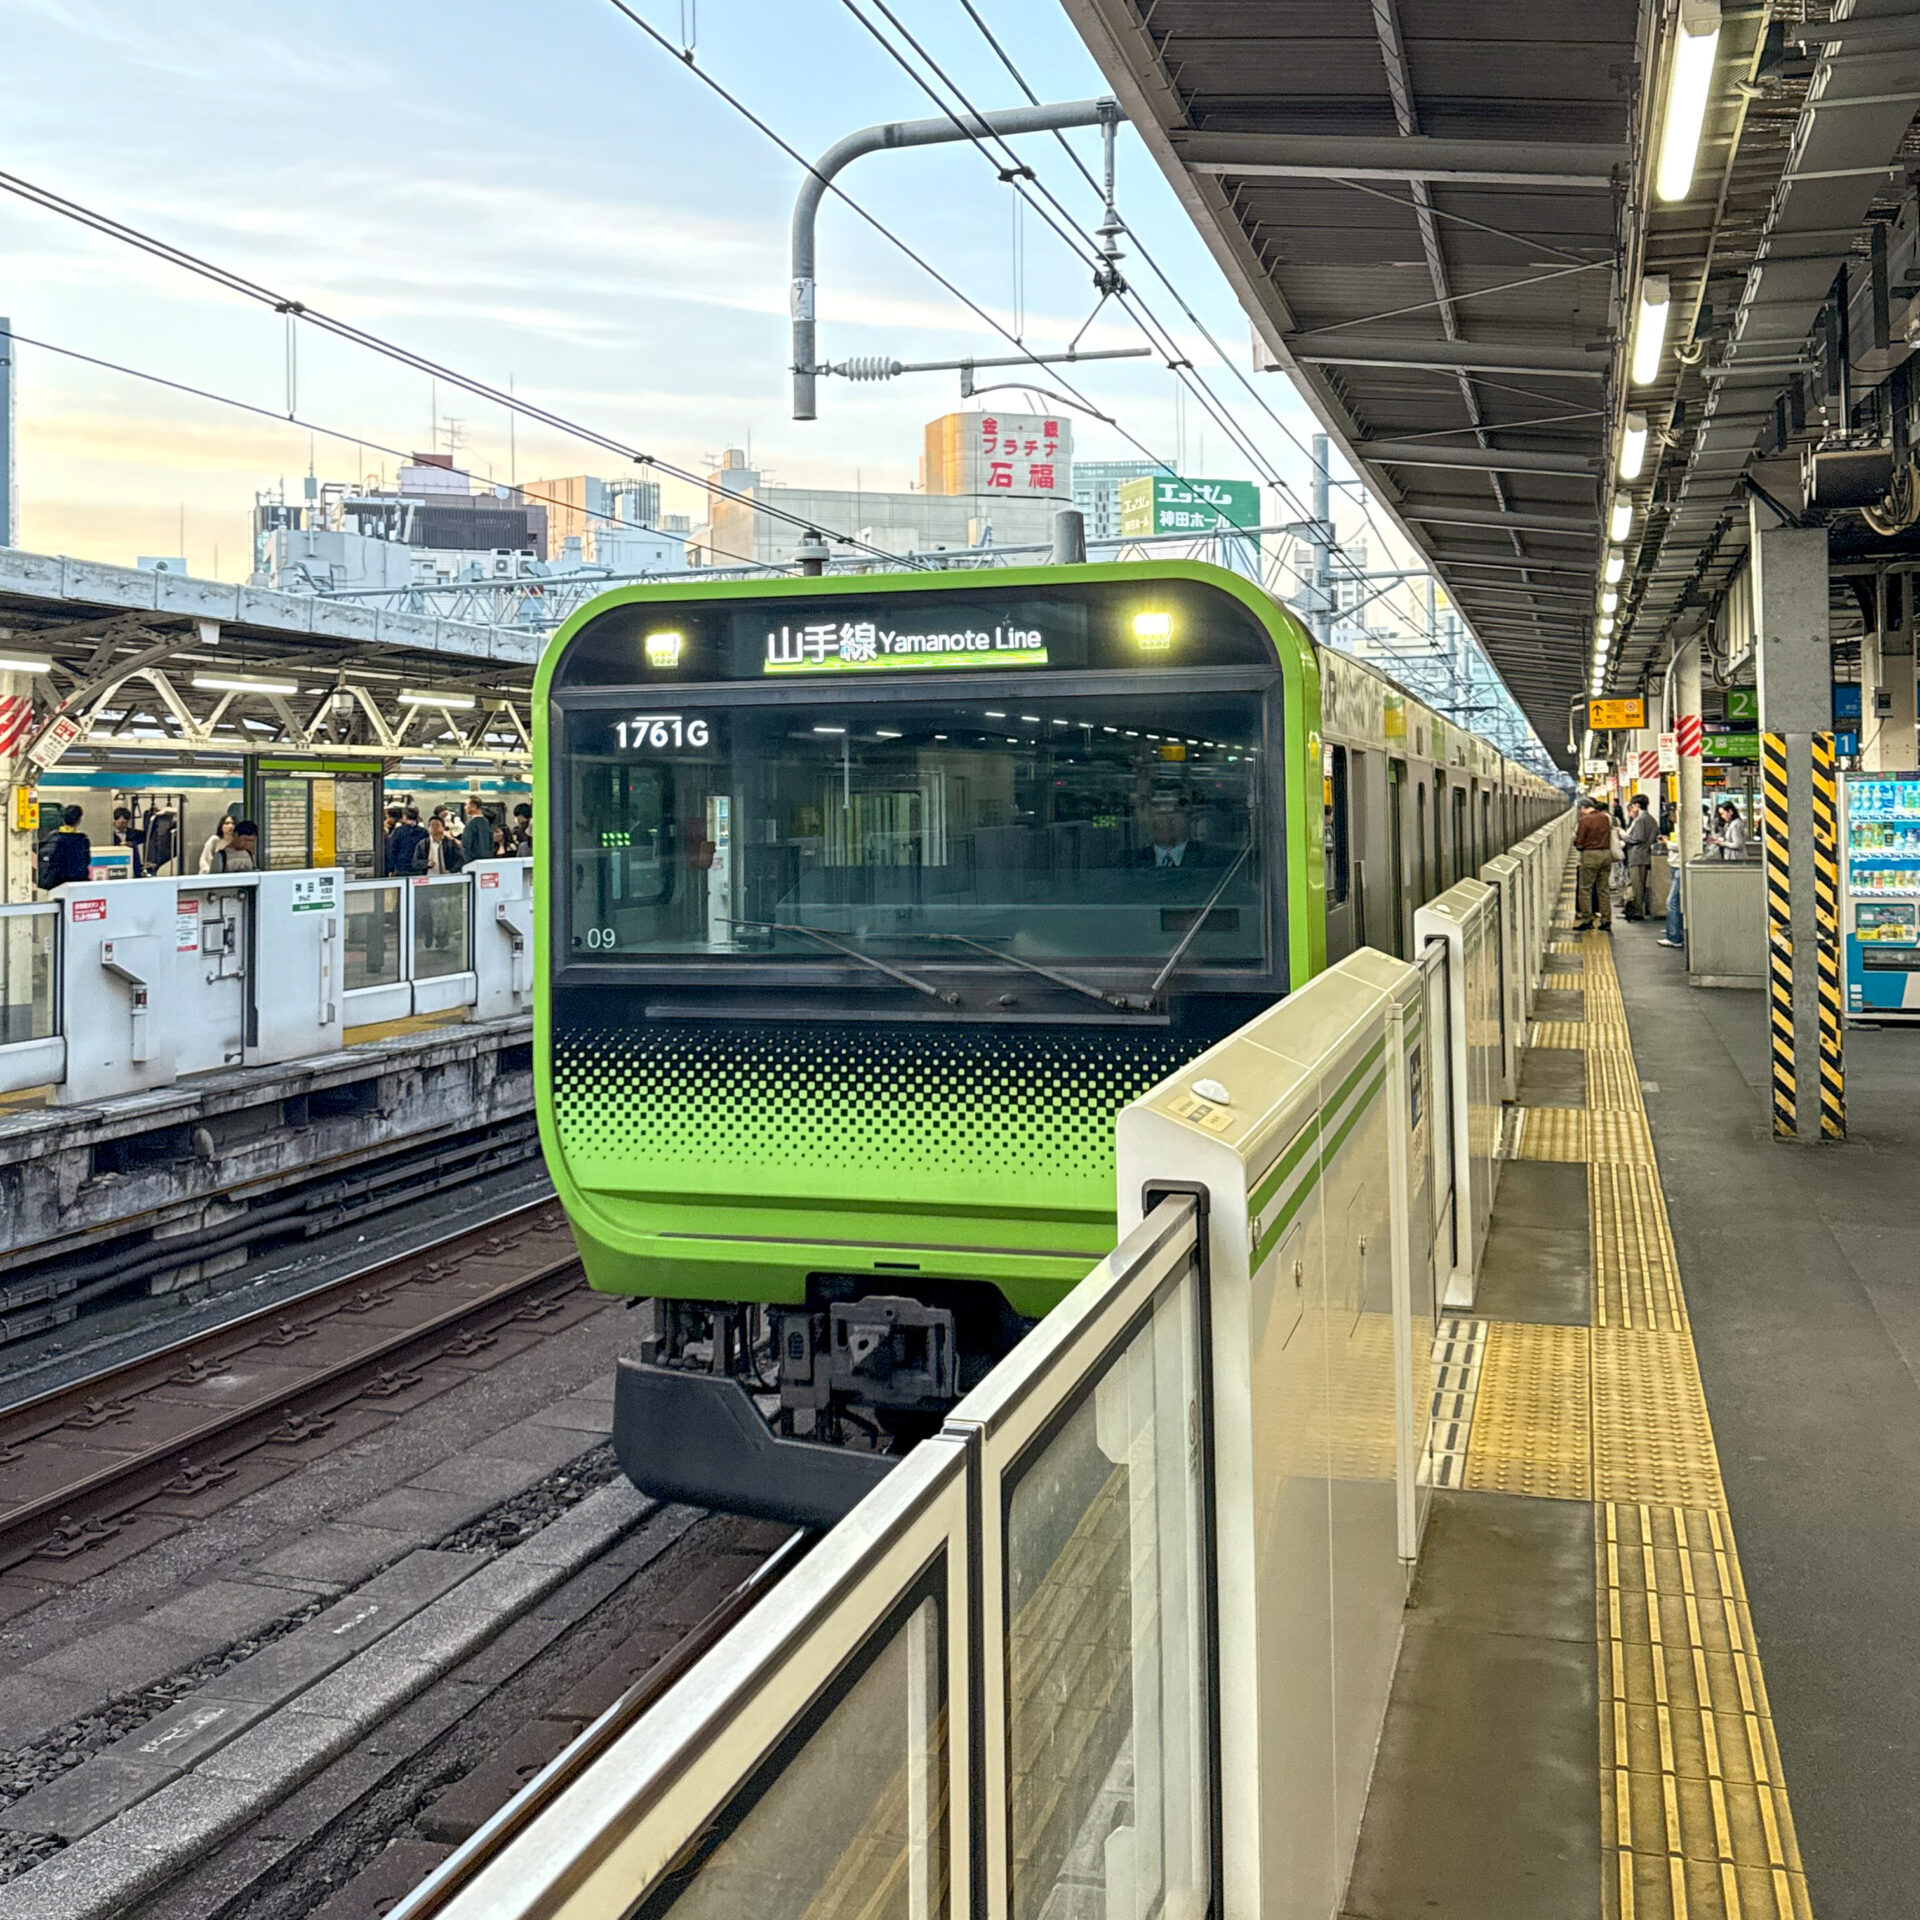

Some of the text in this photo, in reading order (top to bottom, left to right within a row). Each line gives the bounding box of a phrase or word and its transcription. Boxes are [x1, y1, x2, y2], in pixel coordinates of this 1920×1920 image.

[796, 287, 804, 301] 7
[983, 437, 1058, 457] プラチナ
[987, 462, 1054, 490] 石福
[1159, 510, 1231, 529] 神田ホール
[767, 623, 1042, 663] 山手線 Yamanote Line
[1732, 692, 1749, 716] 2
[616, 719, 709, 748] 1761G
[1702, 737, 1714, 756] 2
[1841, 735, 1850, 753] 1
[587, 928, 616, 948] 09
